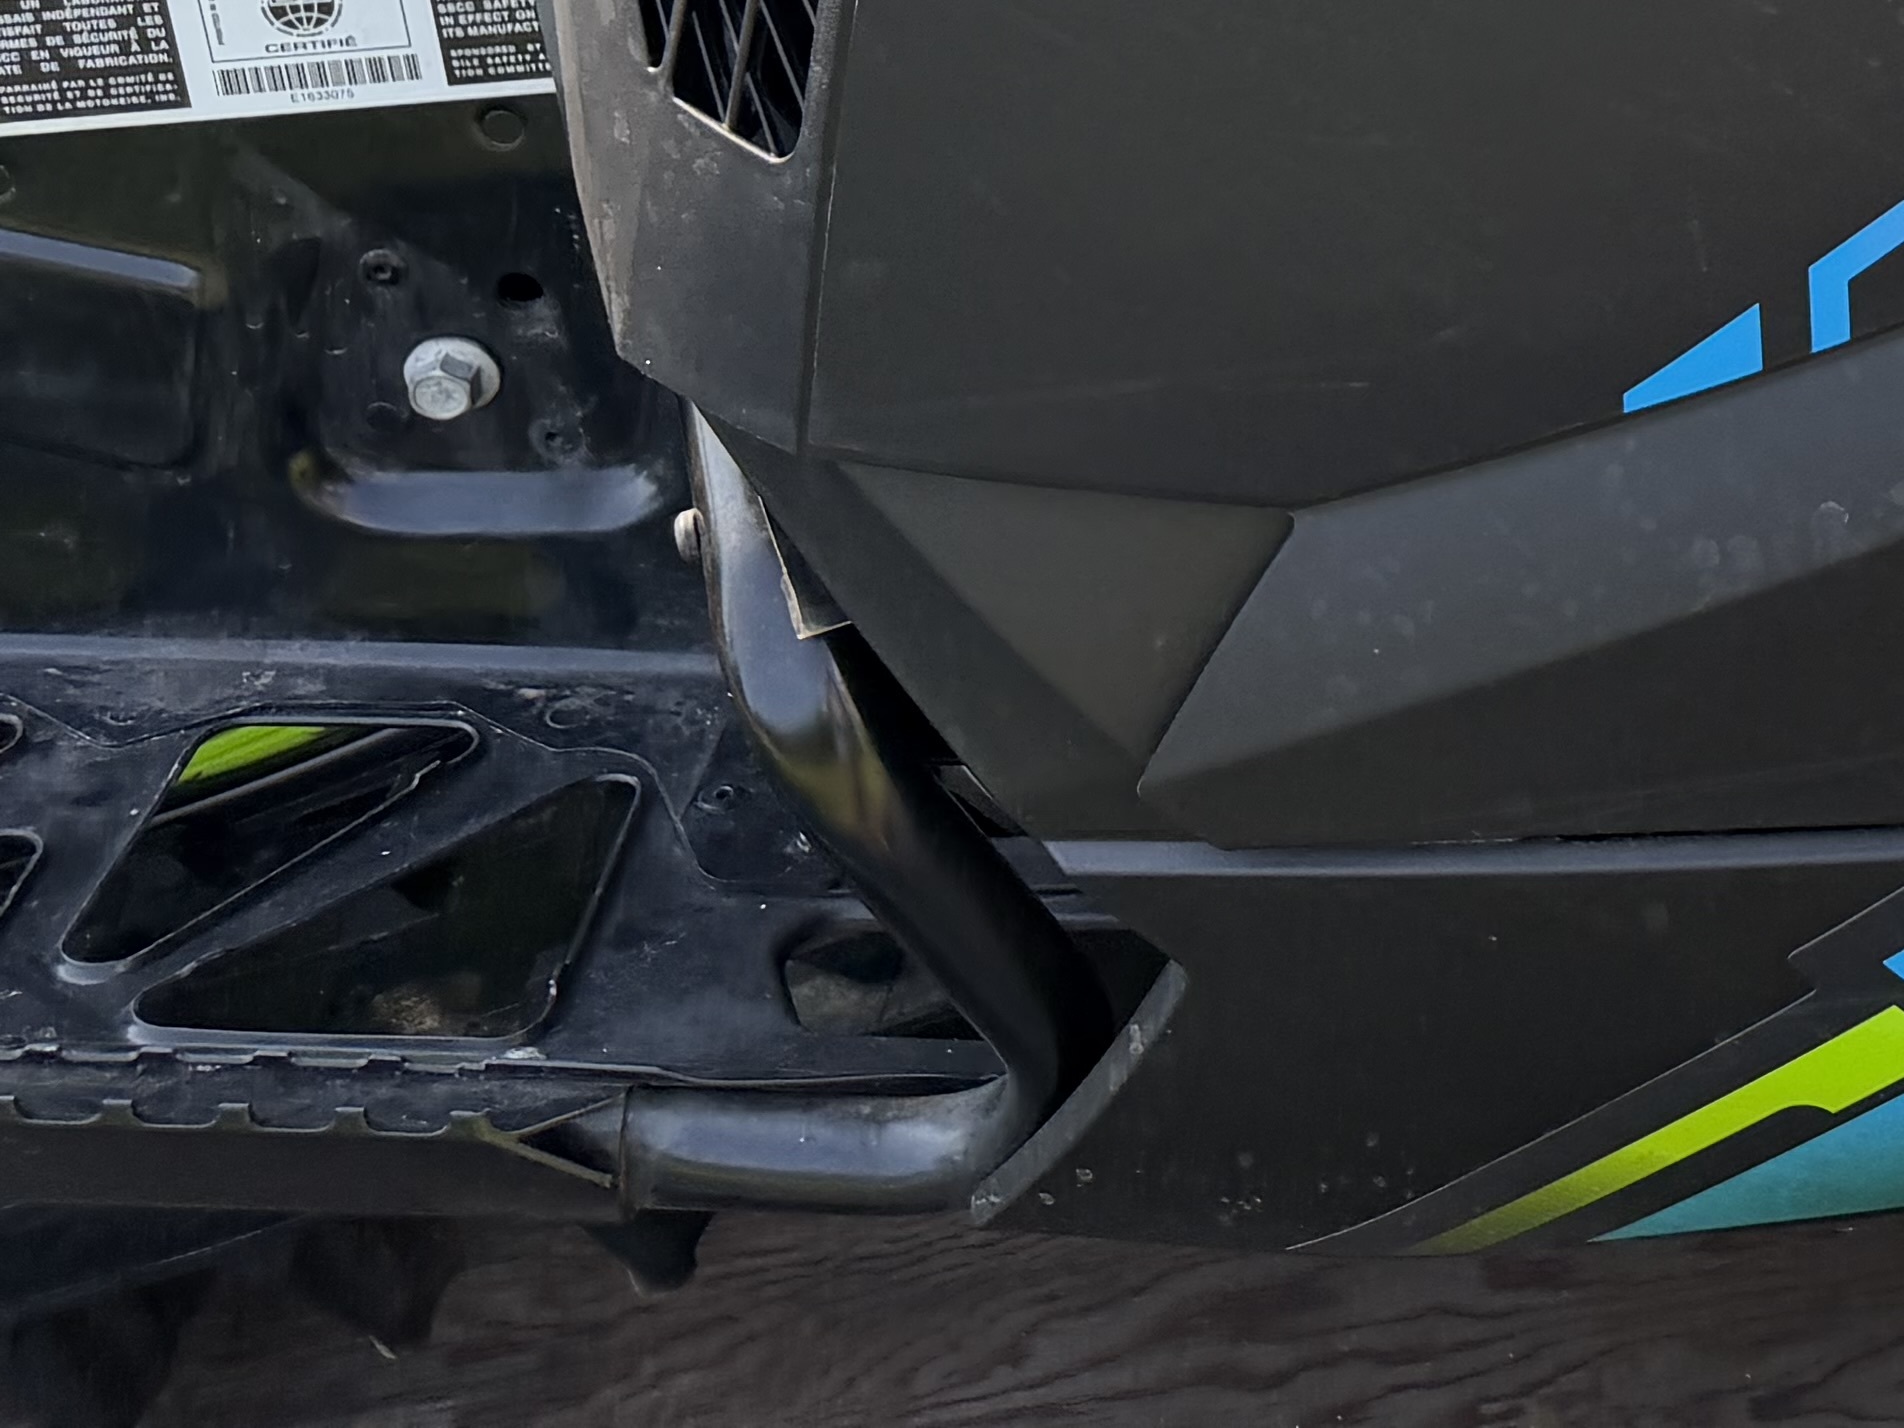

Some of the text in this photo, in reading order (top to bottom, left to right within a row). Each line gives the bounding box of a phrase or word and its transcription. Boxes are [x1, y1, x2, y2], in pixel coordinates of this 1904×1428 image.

[20, 0, 41, 10] UN
[42, 4, 134, 21] INDÉPENDANT
[142, 2, 160, 13] ET
[62, 18, 117, 32] TOUTES
[136, 15, 164, 27] LES
[439, 15, 455, 26] IN
[458, 11, 510, 25] EFFECT
[45, 35, 65, 47] DE
[72, 27, 139, 45] SÉCURITÉ
[146, 28, 166, 39] DU
[442, 27, 465, 39] ITS
[31, 50, 50, 61] EN
[60, 43, 120, 58] VIQUEUR
[151, 40, 169, 51] LA
[264, 35, 358, 53] CERTIFIÉ
[40, 61, 60, 73] DE
